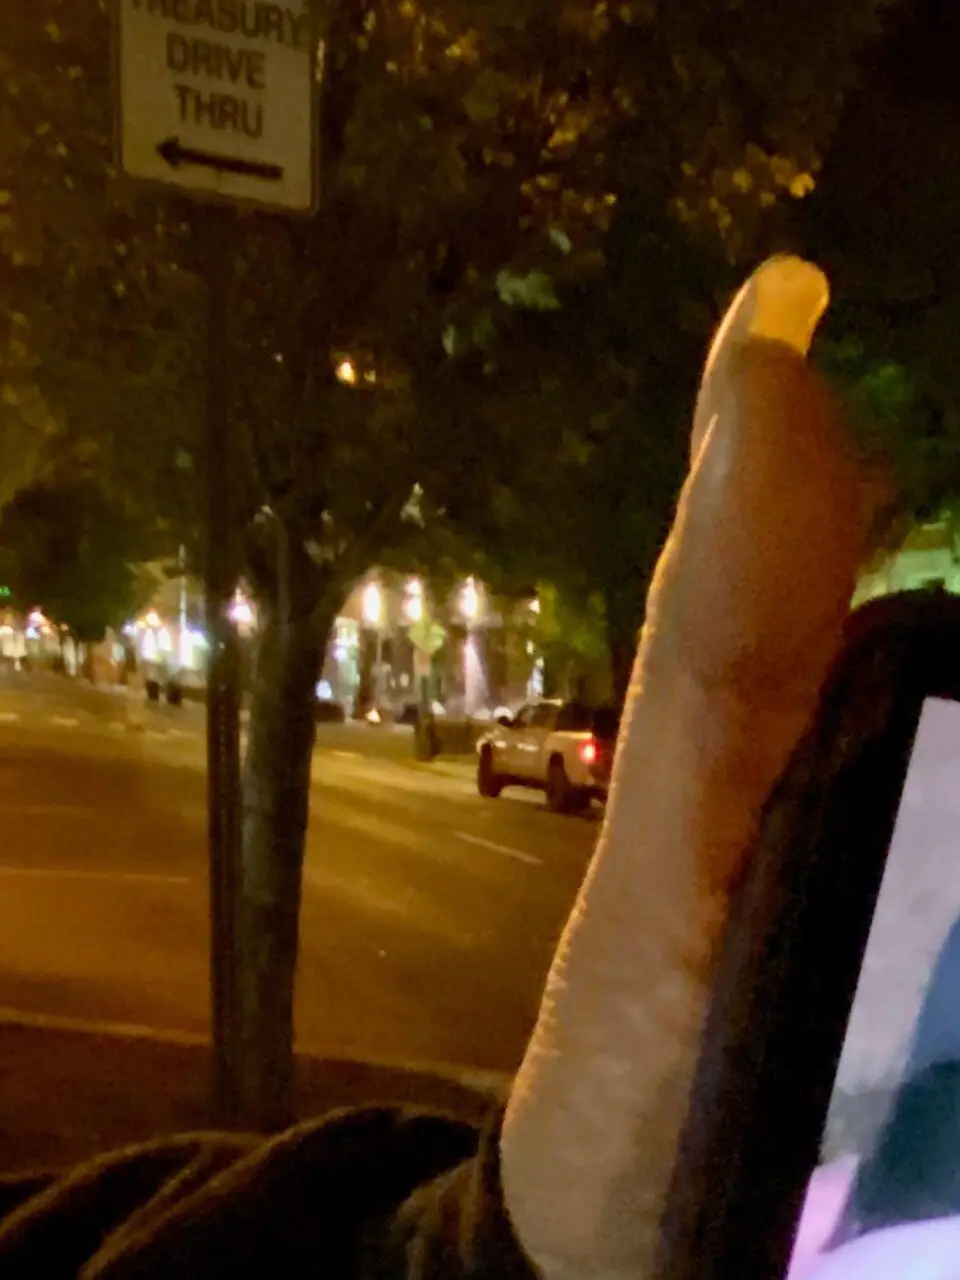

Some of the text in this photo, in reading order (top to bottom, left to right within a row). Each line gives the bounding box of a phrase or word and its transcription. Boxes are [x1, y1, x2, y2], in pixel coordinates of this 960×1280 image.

[131, 0, 308, 46] EASURY
[167, 31, 266, 90] DRIVE
[173, 84, 264, 140] THRU
